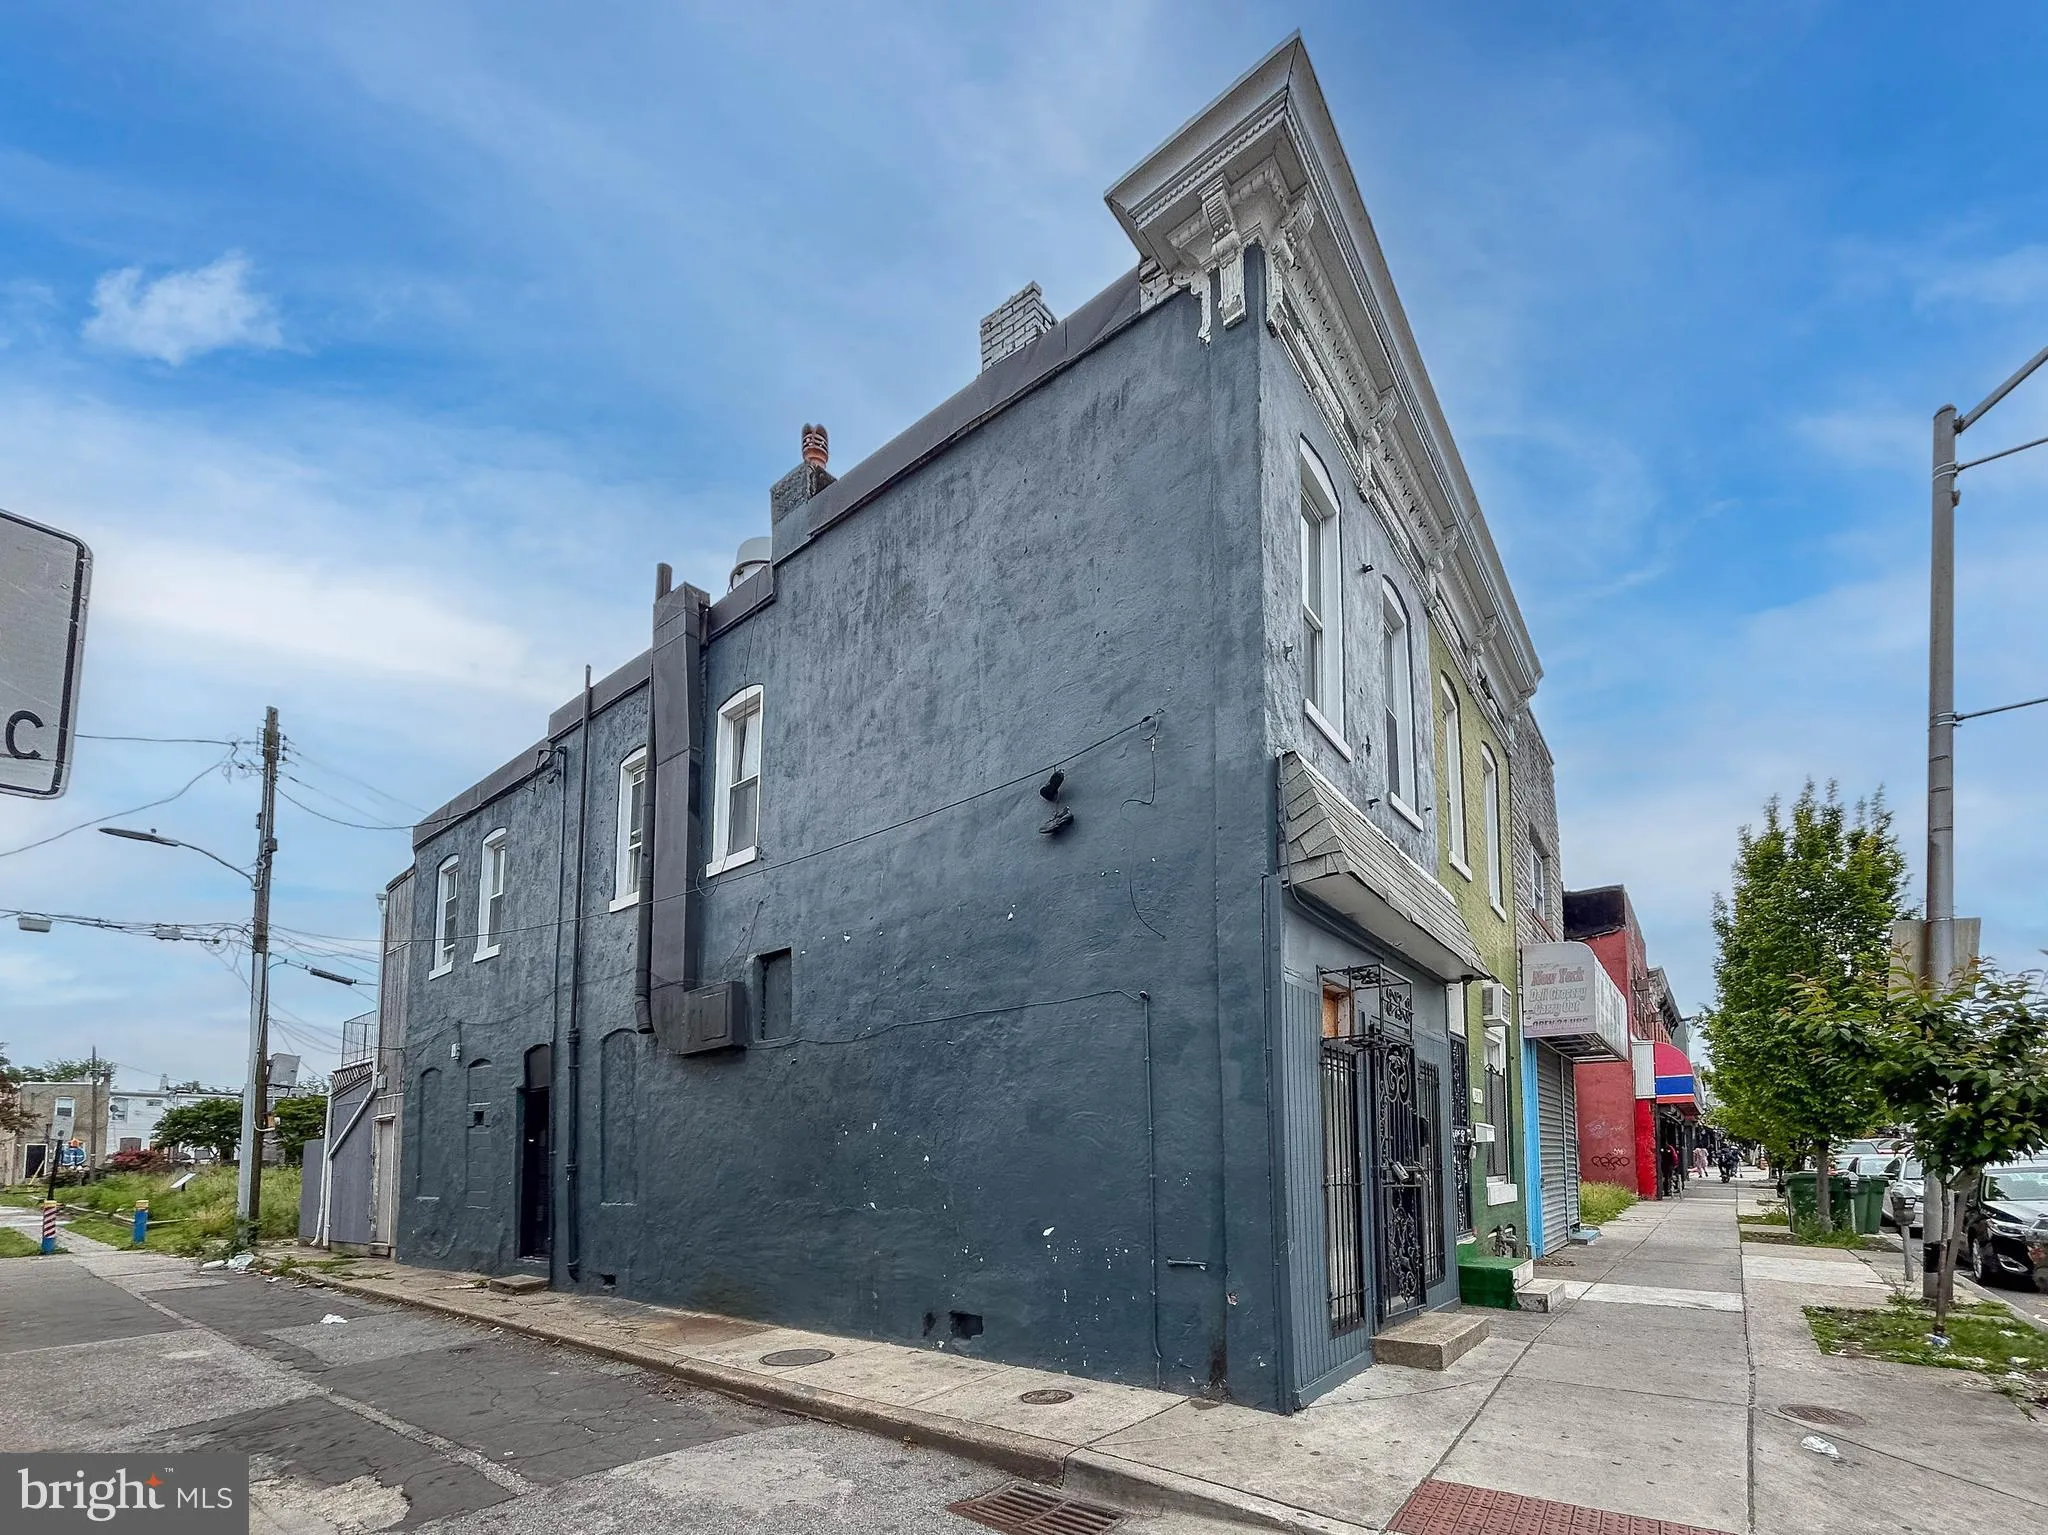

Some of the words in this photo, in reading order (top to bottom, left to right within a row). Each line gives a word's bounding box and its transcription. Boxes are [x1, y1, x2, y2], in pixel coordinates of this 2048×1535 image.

[1531, 970, 1557, 986] New
[1559, 966, 1585, 983] York
[1529, 987, 1548, 1002] Deli
[1549, 986, 1587, 1001] Grocery
[1533, 1001, 1561, 1017] Carry
[1562, 1000, 1581, 1013] Out
[1532, 1019, 1555, 1031] OPEN
